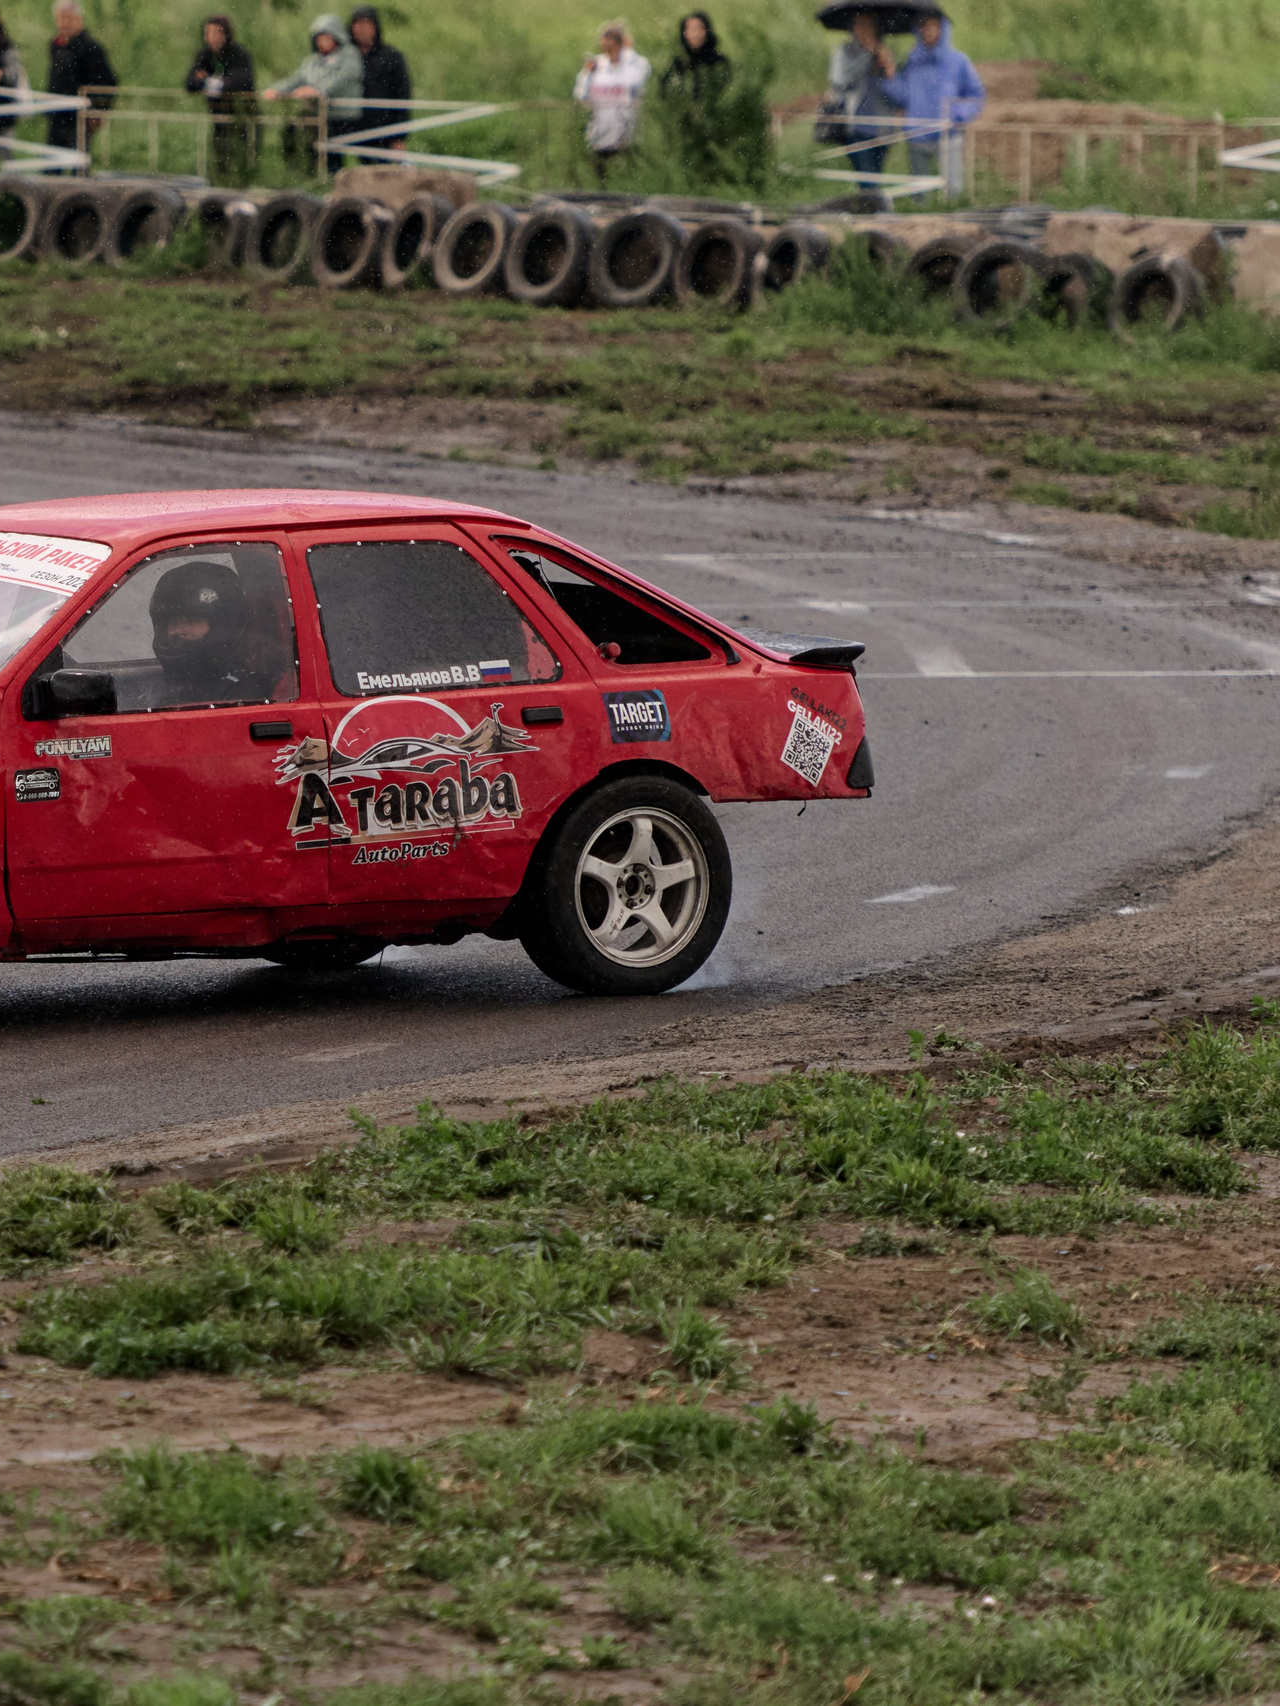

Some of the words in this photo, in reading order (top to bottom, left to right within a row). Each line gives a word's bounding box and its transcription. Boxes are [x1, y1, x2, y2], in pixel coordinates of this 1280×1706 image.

[30, 570, 62, 582] СЕЗОН
[58, 575, 88, 588] 202
[609, 701, 663, 724] TARGET
[787, 700, 843, 745] GELLAKI22
[35, 737, 110, 756] PONULYAM
[352, 841, 449, 865] AutoParts
